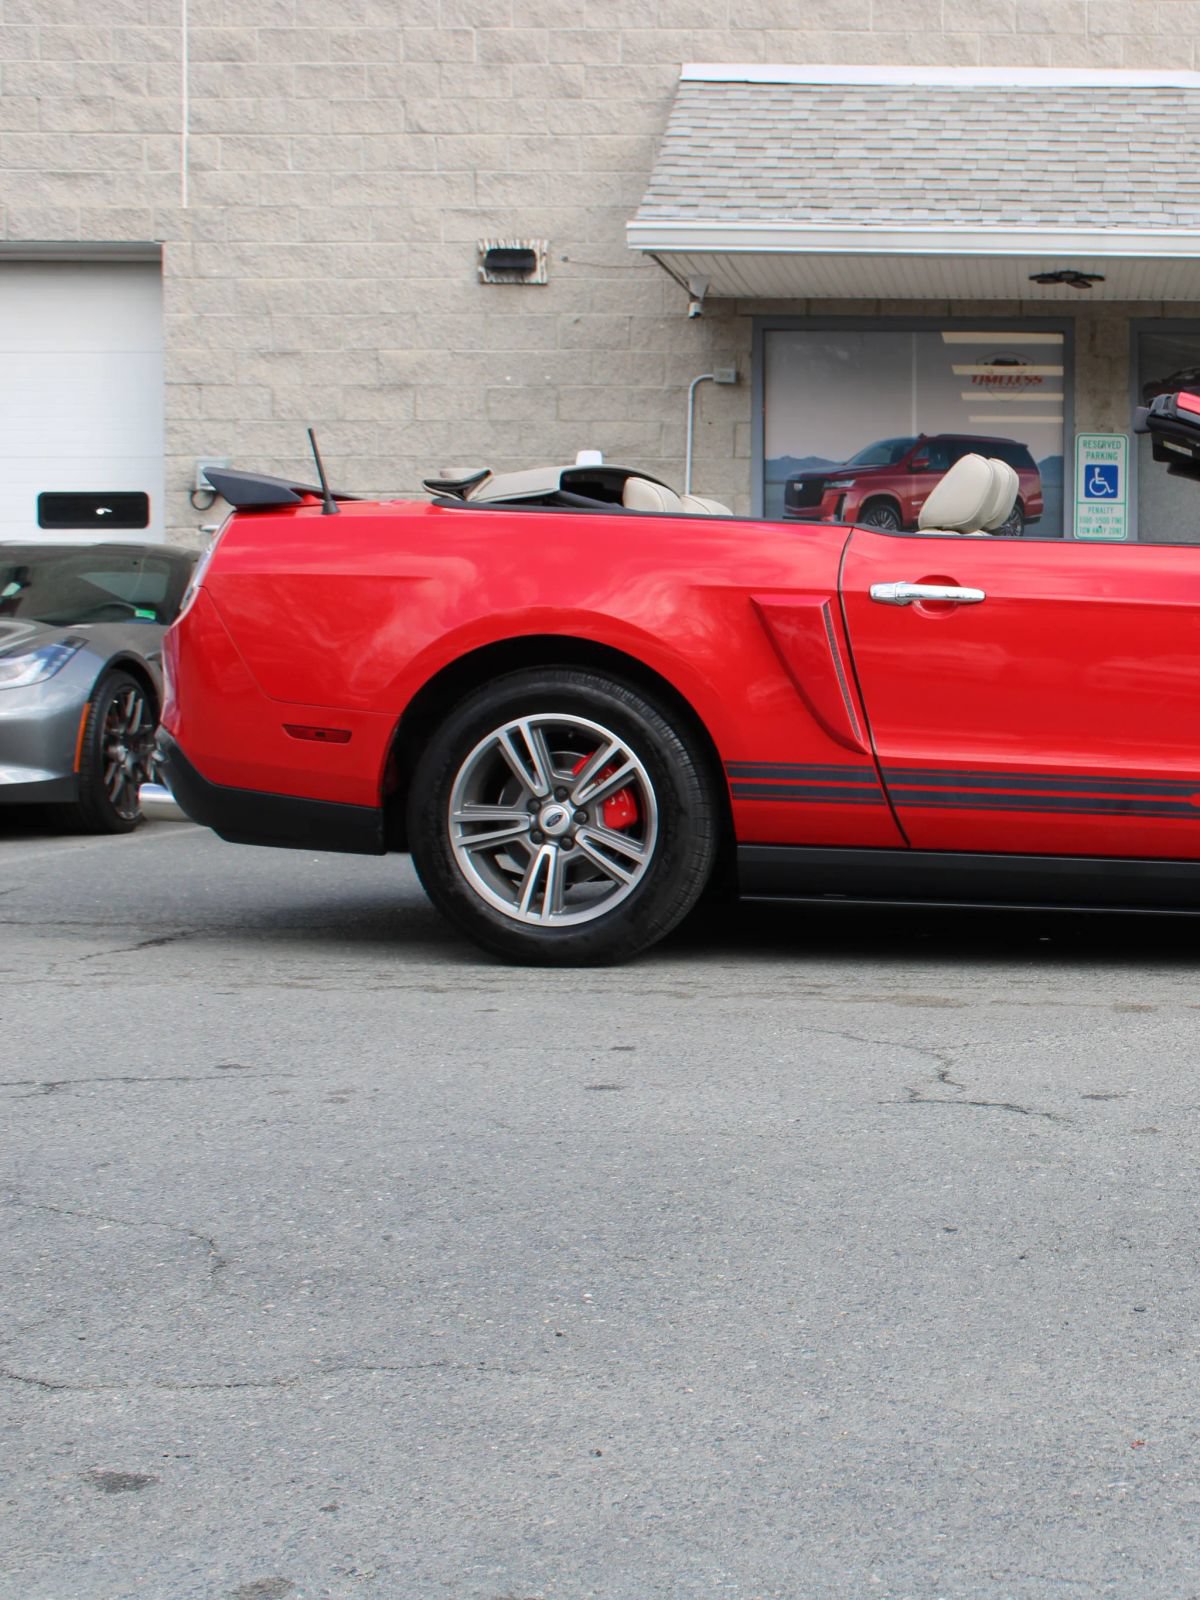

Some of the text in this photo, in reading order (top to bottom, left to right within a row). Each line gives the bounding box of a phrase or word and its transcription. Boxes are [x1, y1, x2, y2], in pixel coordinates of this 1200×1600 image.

[1083, 440, 1121, 449] RESERVED
[1086, 451, 1118, 460] PARKING
[1088, 506, 1114, 514] PENALTY
